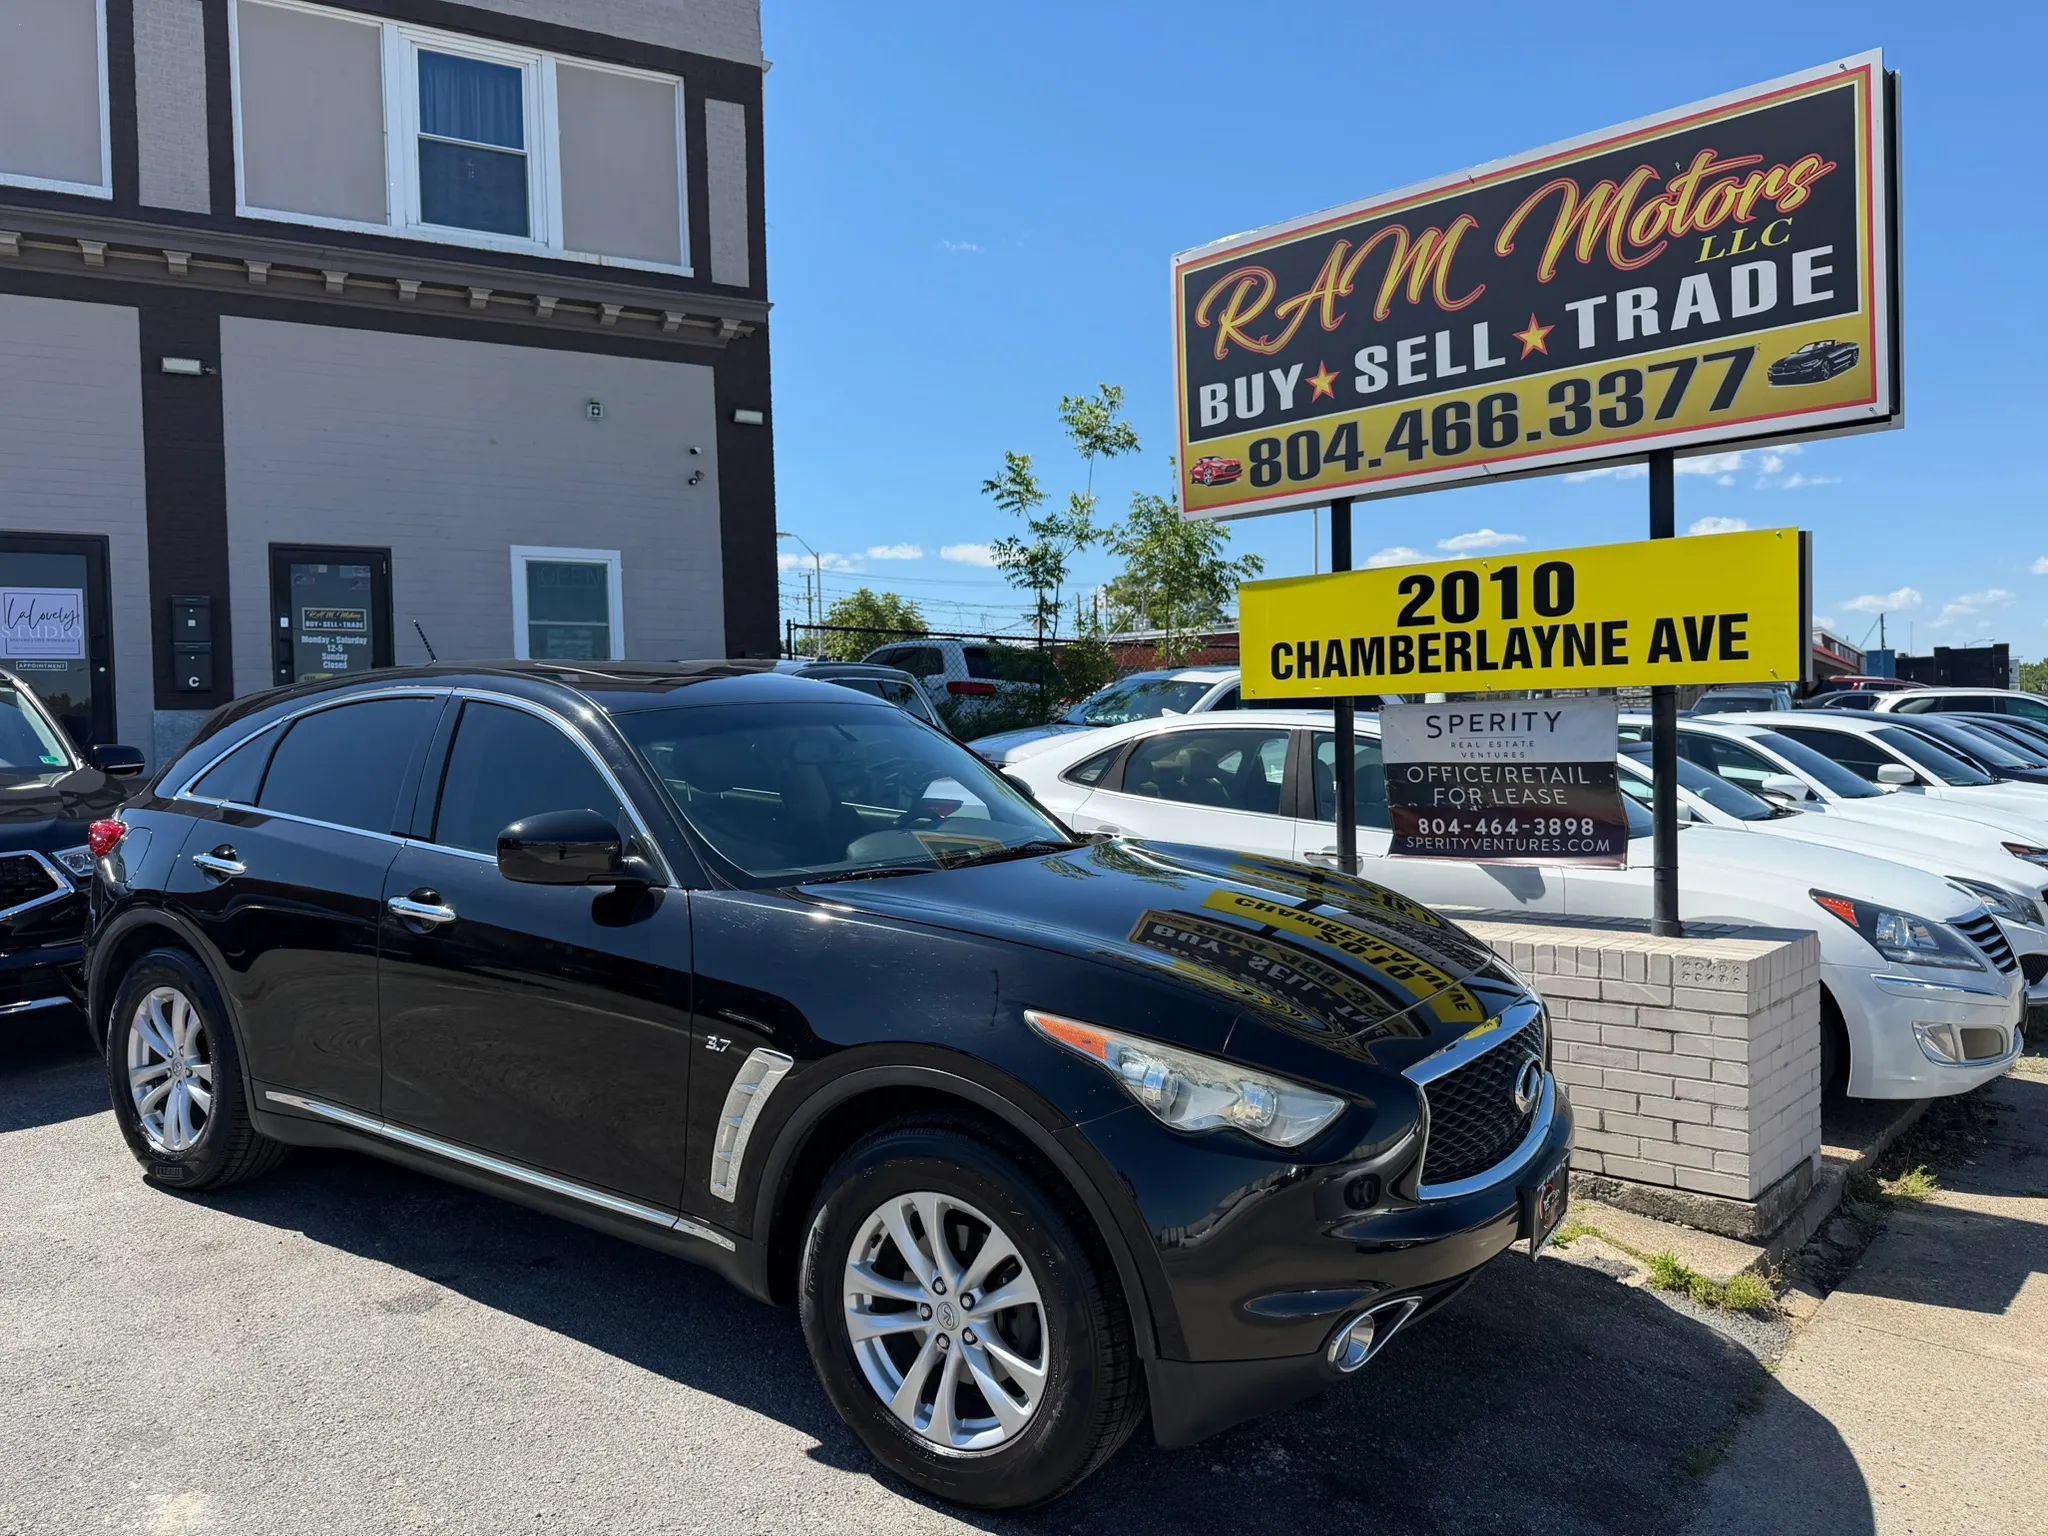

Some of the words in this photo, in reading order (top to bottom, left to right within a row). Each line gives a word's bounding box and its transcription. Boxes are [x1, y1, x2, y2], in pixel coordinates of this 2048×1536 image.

[1494, 148, 1837, 284] Motors
[1694, 217, 1793, 264] LLC
[1200, 363, 1304, 427] BUY
[1354, 321, 1506, 395] SELL
[1565, 245, 1835, 350] TRADE
[1249, 345, 1758, 489] 804.466.3377
[1397, 561, 1576, 628] 2010
[1, 624, 82, 640] STUDIO
[301, 635, 330, 644] Monday
[336, 636, 368, 645] Saturday
[1271, 620, 1629, 681] CHAMBERLAYNE
[1647, 612, 1749, 664] AVE
[321, 653, 348, 661] Sunday
[323, 661, 347, 669] Closed
[188, 676, 200, 687] C
[1426, 711, 1563, 739] SPERITY
[1451, 741, 1480, 749] REAL
[1489, 740, 1535, 748] ESTATE
[1407, 766, 1590, 784] OFFICE/RETAIL
[1433, 788, 1482, 805] FOR
[1492, 788, 1568, 805] LEASE
[1418, 817, 1594, 836] 804-464-3898
[1406, 836, 1610, 852] SPERITYVENTURES.COM
[705, 1035, 732, 1052] 3.7
